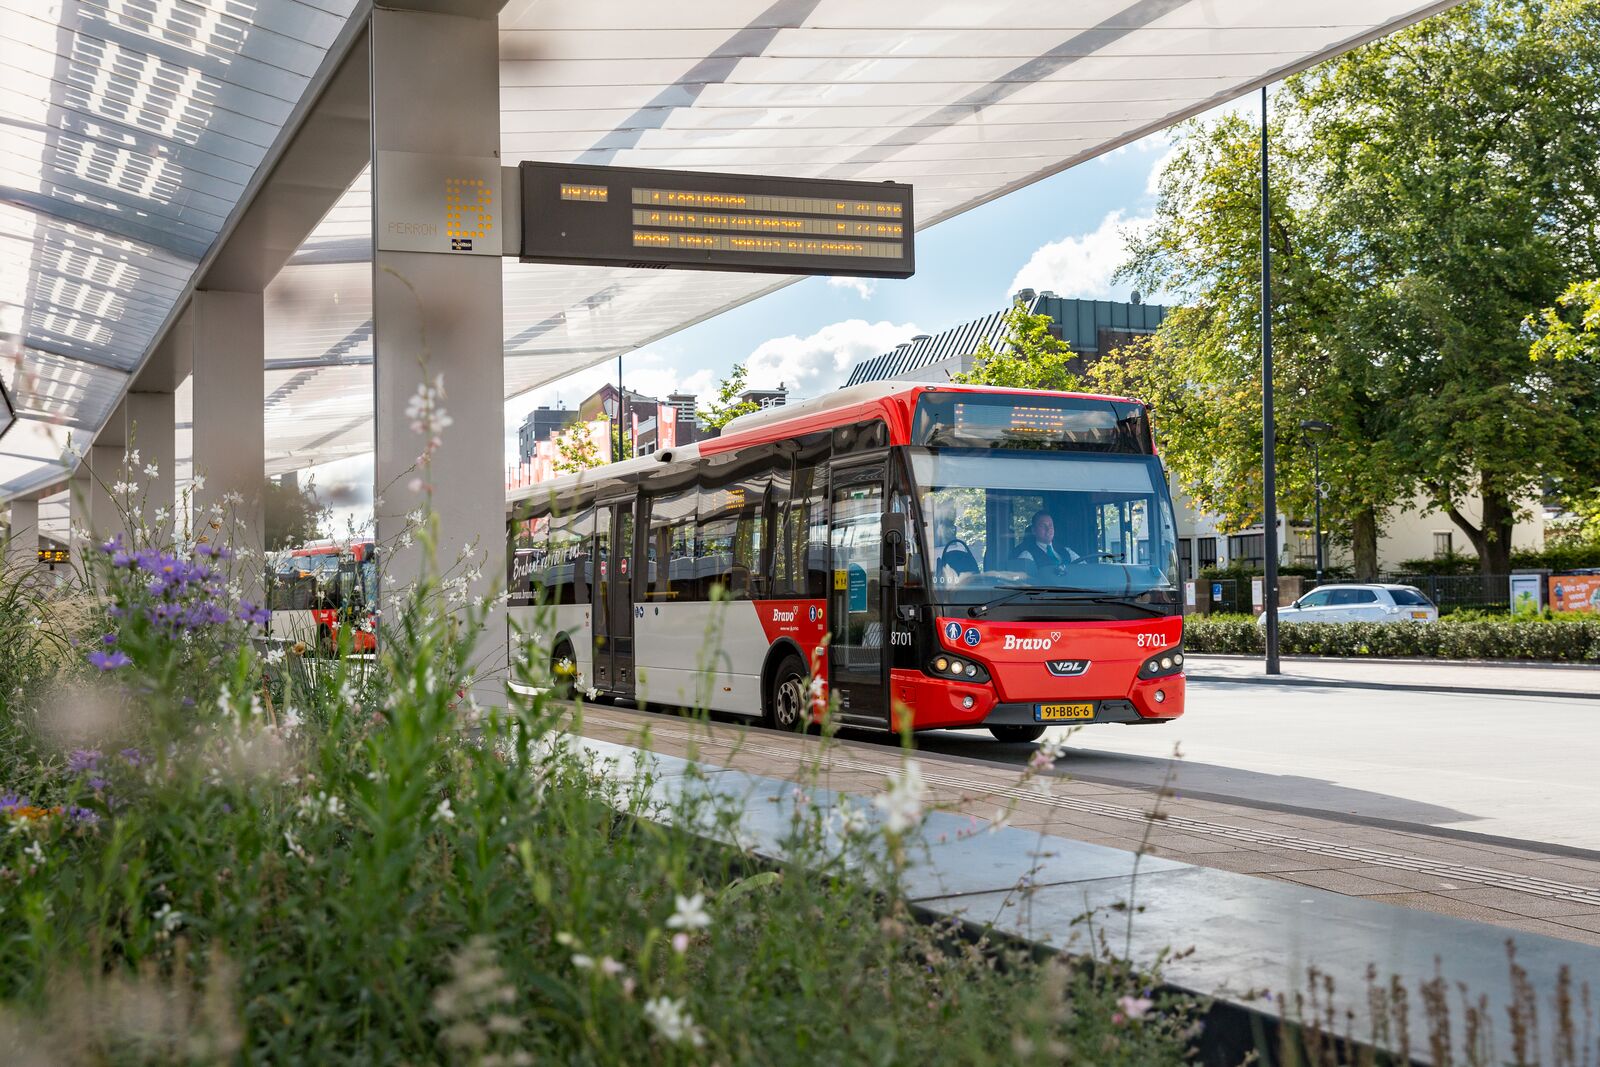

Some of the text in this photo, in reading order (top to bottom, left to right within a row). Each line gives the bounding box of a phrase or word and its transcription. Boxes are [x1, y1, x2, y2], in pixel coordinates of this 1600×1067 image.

[388, 178, 492, 239] PERRON B
[773, 608, 794, 622] Bravo
[891, 631, 912, 646] 8701
[1003, 634, 1051, 650] Bravo
[1137, 633, 1168, 647] 8701
[1052, 662, 1082, 672] VDL
[1045, 706, 1090, 717] 91-BBG-6
